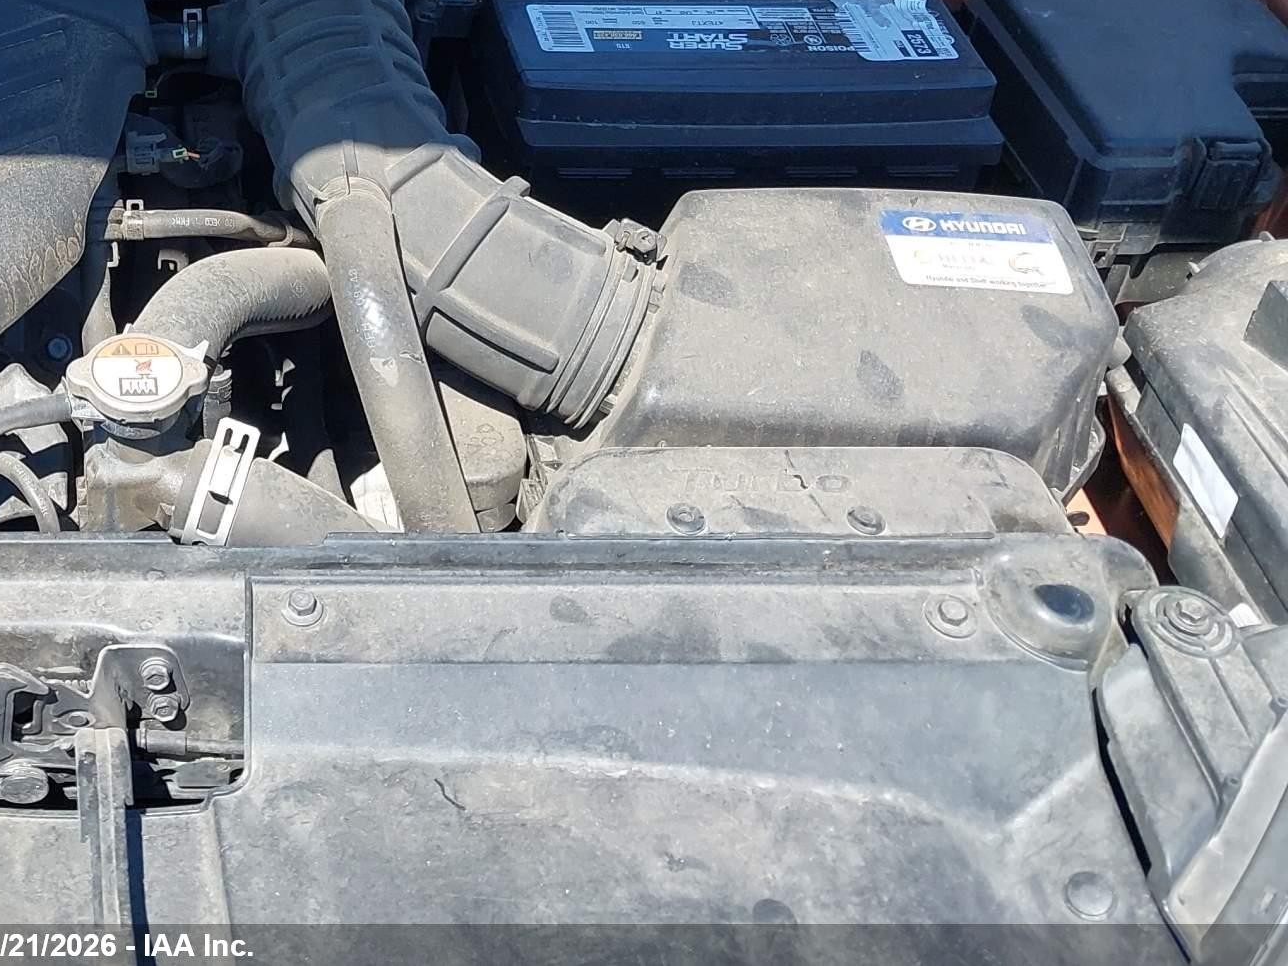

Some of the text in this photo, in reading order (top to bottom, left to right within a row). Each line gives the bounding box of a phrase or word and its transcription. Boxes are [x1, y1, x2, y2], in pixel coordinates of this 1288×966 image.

[666, 33, 748, 43] START
[669, 41, 743, 51] SUPER
[808, 45, 856, 53] POISON
[906, 33, 932, 55] 2573
[940, 219, 1028, 235] HYUNDAI
